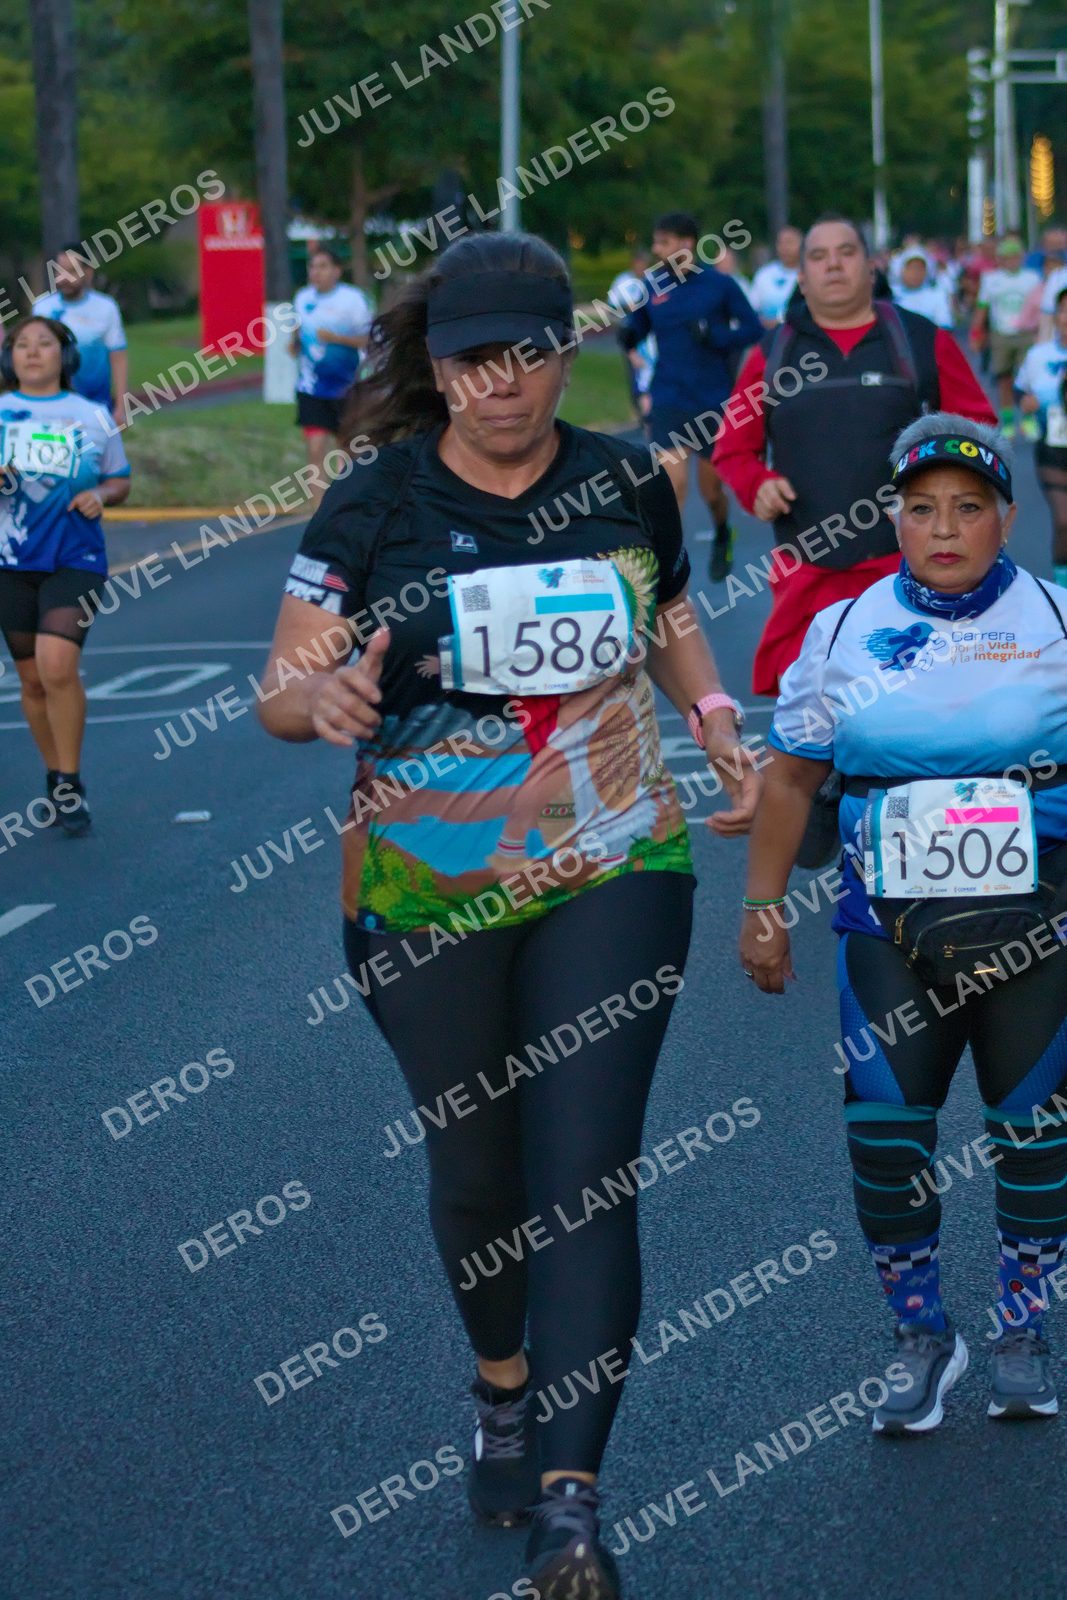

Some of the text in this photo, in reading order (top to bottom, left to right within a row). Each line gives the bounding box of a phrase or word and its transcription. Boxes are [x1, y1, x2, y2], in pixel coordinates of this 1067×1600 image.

[9, 441, 71, 469] 1102
[944, 440, 1007, 480] COVID
[473, 614, 621, 677] 1586
[951, 631, 1015, 642] Carrera
[988, 641, 1017, 650] Vida
[974, 649, 1041, 663] Integridad
[892, 827, 1029, 880] 1506
